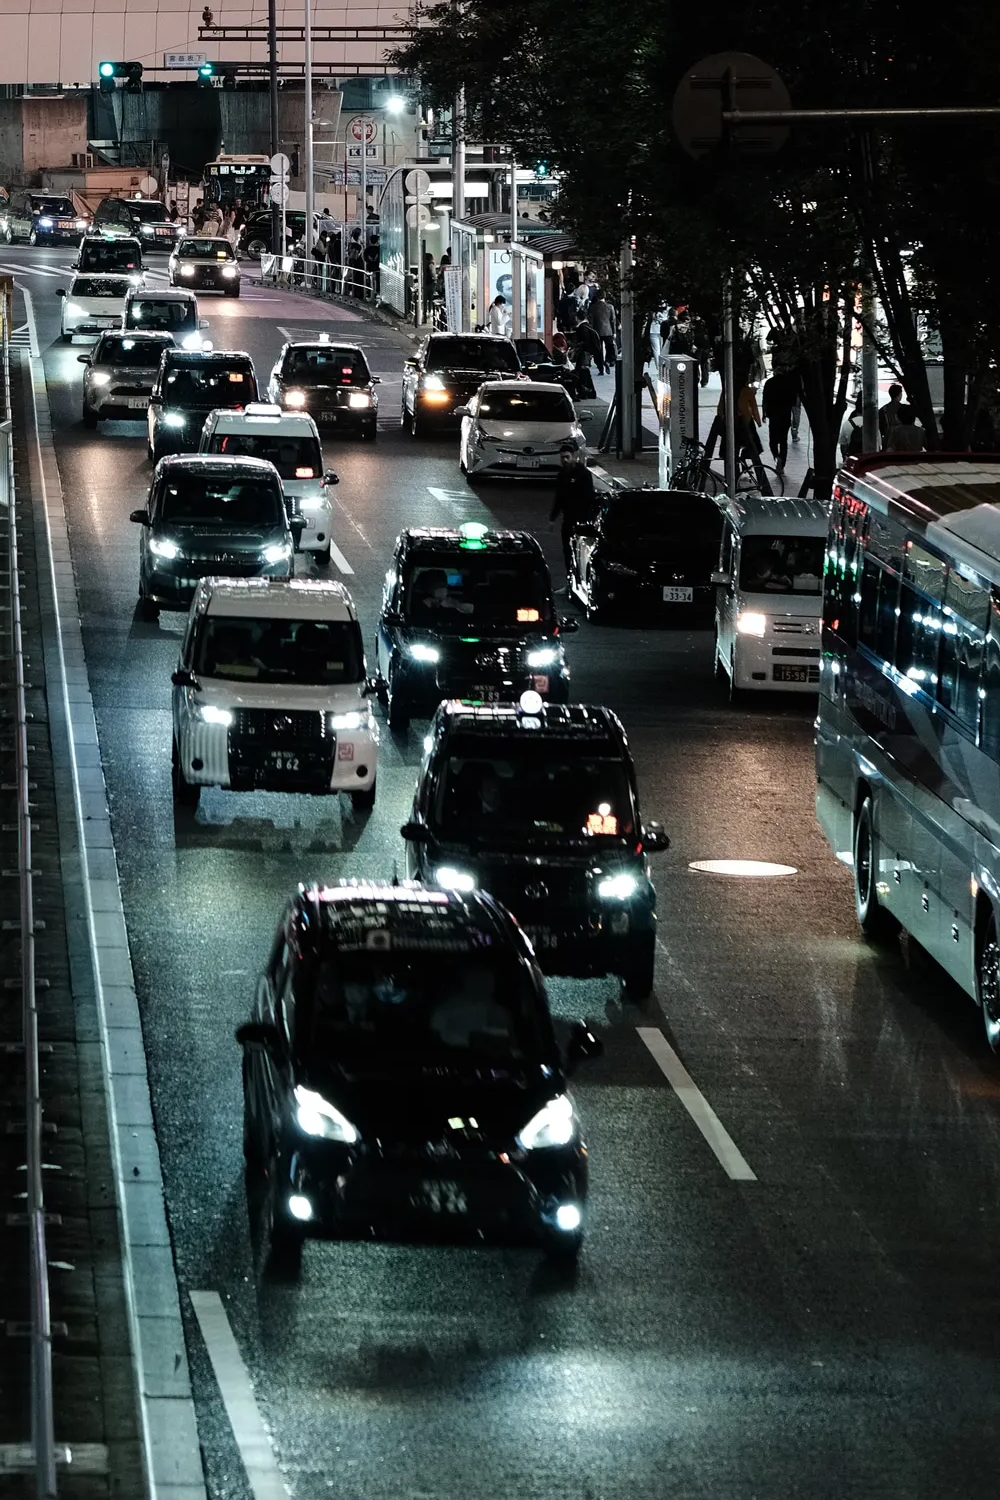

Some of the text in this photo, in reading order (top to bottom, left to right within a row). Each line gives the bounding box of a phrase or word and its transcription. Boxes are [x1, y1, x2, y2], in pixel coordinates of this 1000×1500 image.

[494, 252, 512, 263] LO
[670, 592, 692, 601] 33-34
[781, 670, 806, 681] 15-98
